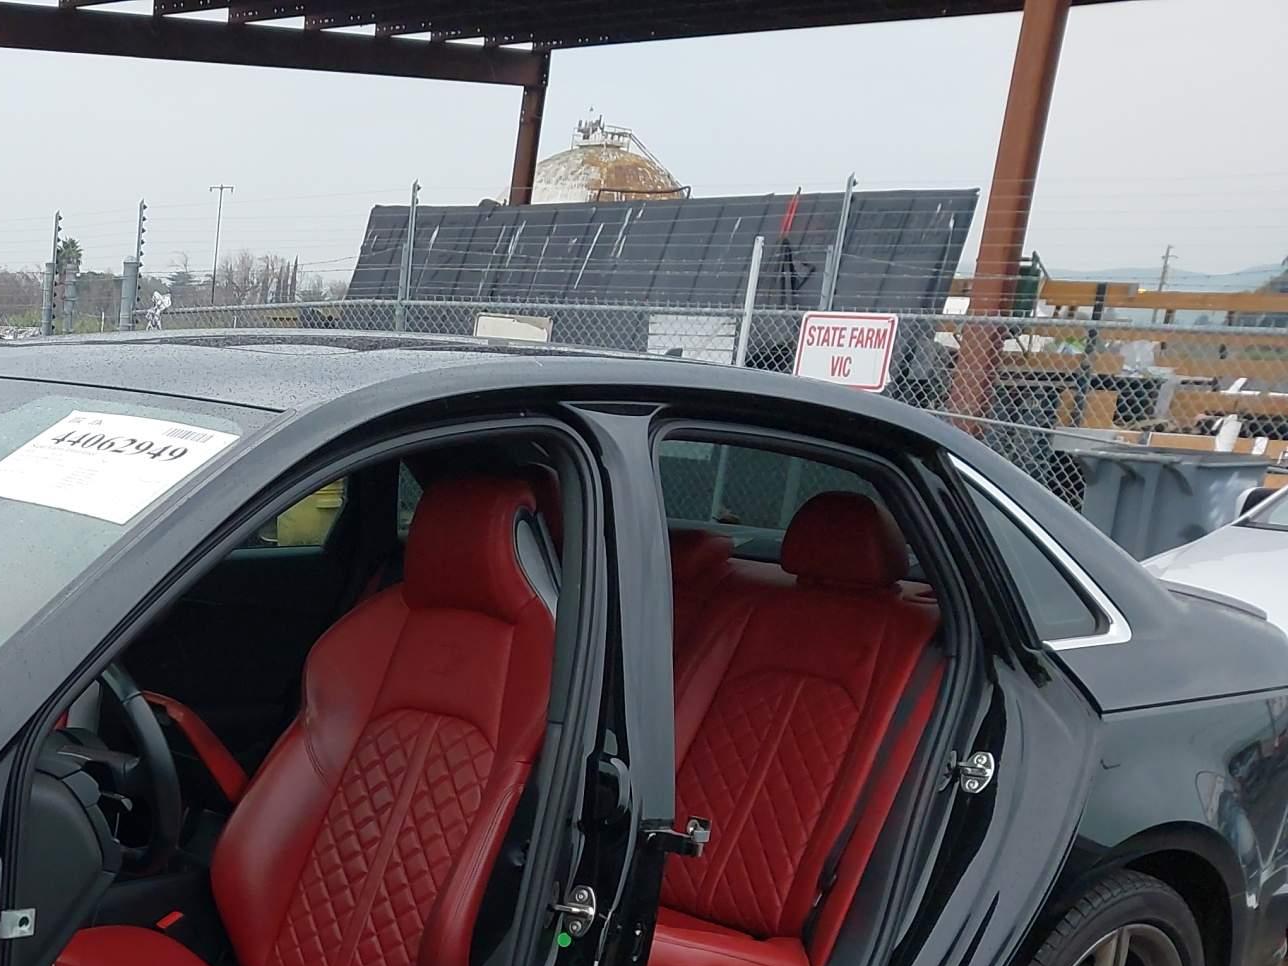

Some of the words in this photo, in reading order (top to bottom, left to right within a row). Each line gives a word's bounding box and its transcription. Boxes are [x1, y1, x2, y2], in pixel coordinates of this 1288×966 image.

[806, 325, 847, 347] STATE
[849, 327, 888, 349] FARM
[830, 355, 852, 377] VIC
[51, 429, 189, 462] 44062949
